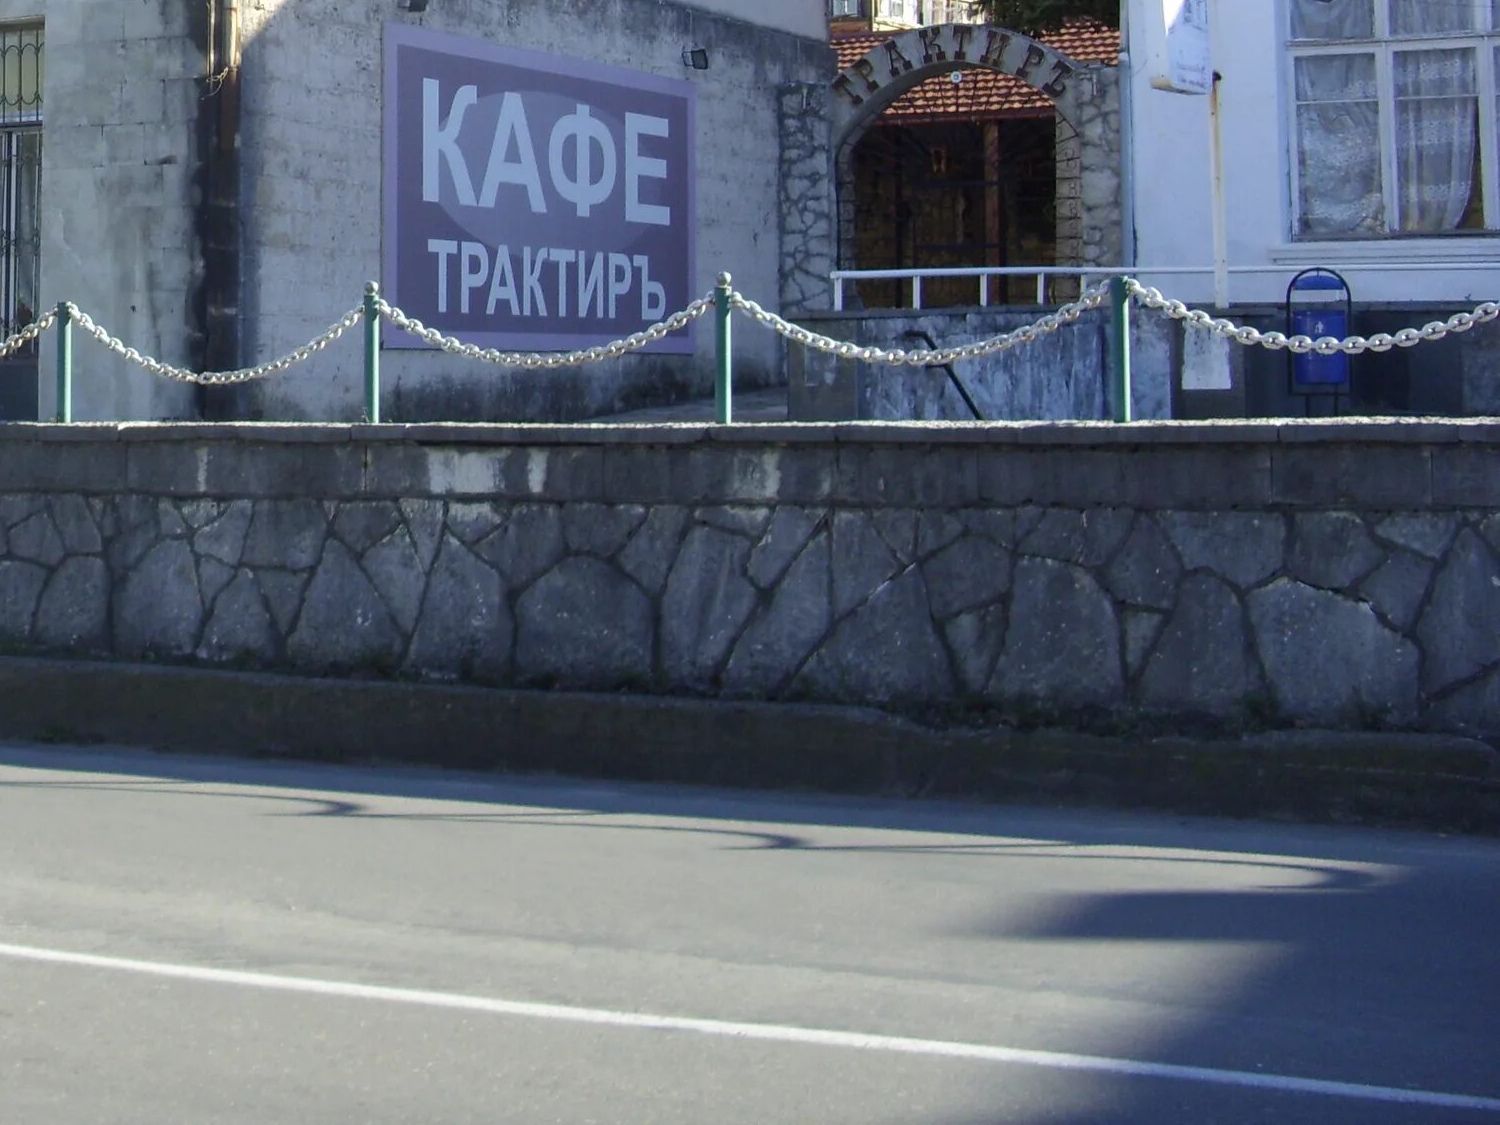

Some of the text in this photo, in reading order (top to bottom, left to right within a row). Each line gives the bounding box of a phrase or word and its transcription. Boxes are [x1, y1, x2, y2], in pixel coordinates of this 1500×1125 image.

[831, 25, 1073, 105] ТРАКТИРЪ
[422, 77, 670, 226] КАФЕ
[427, 238, 667, 321] ТРАКТИРЪ
